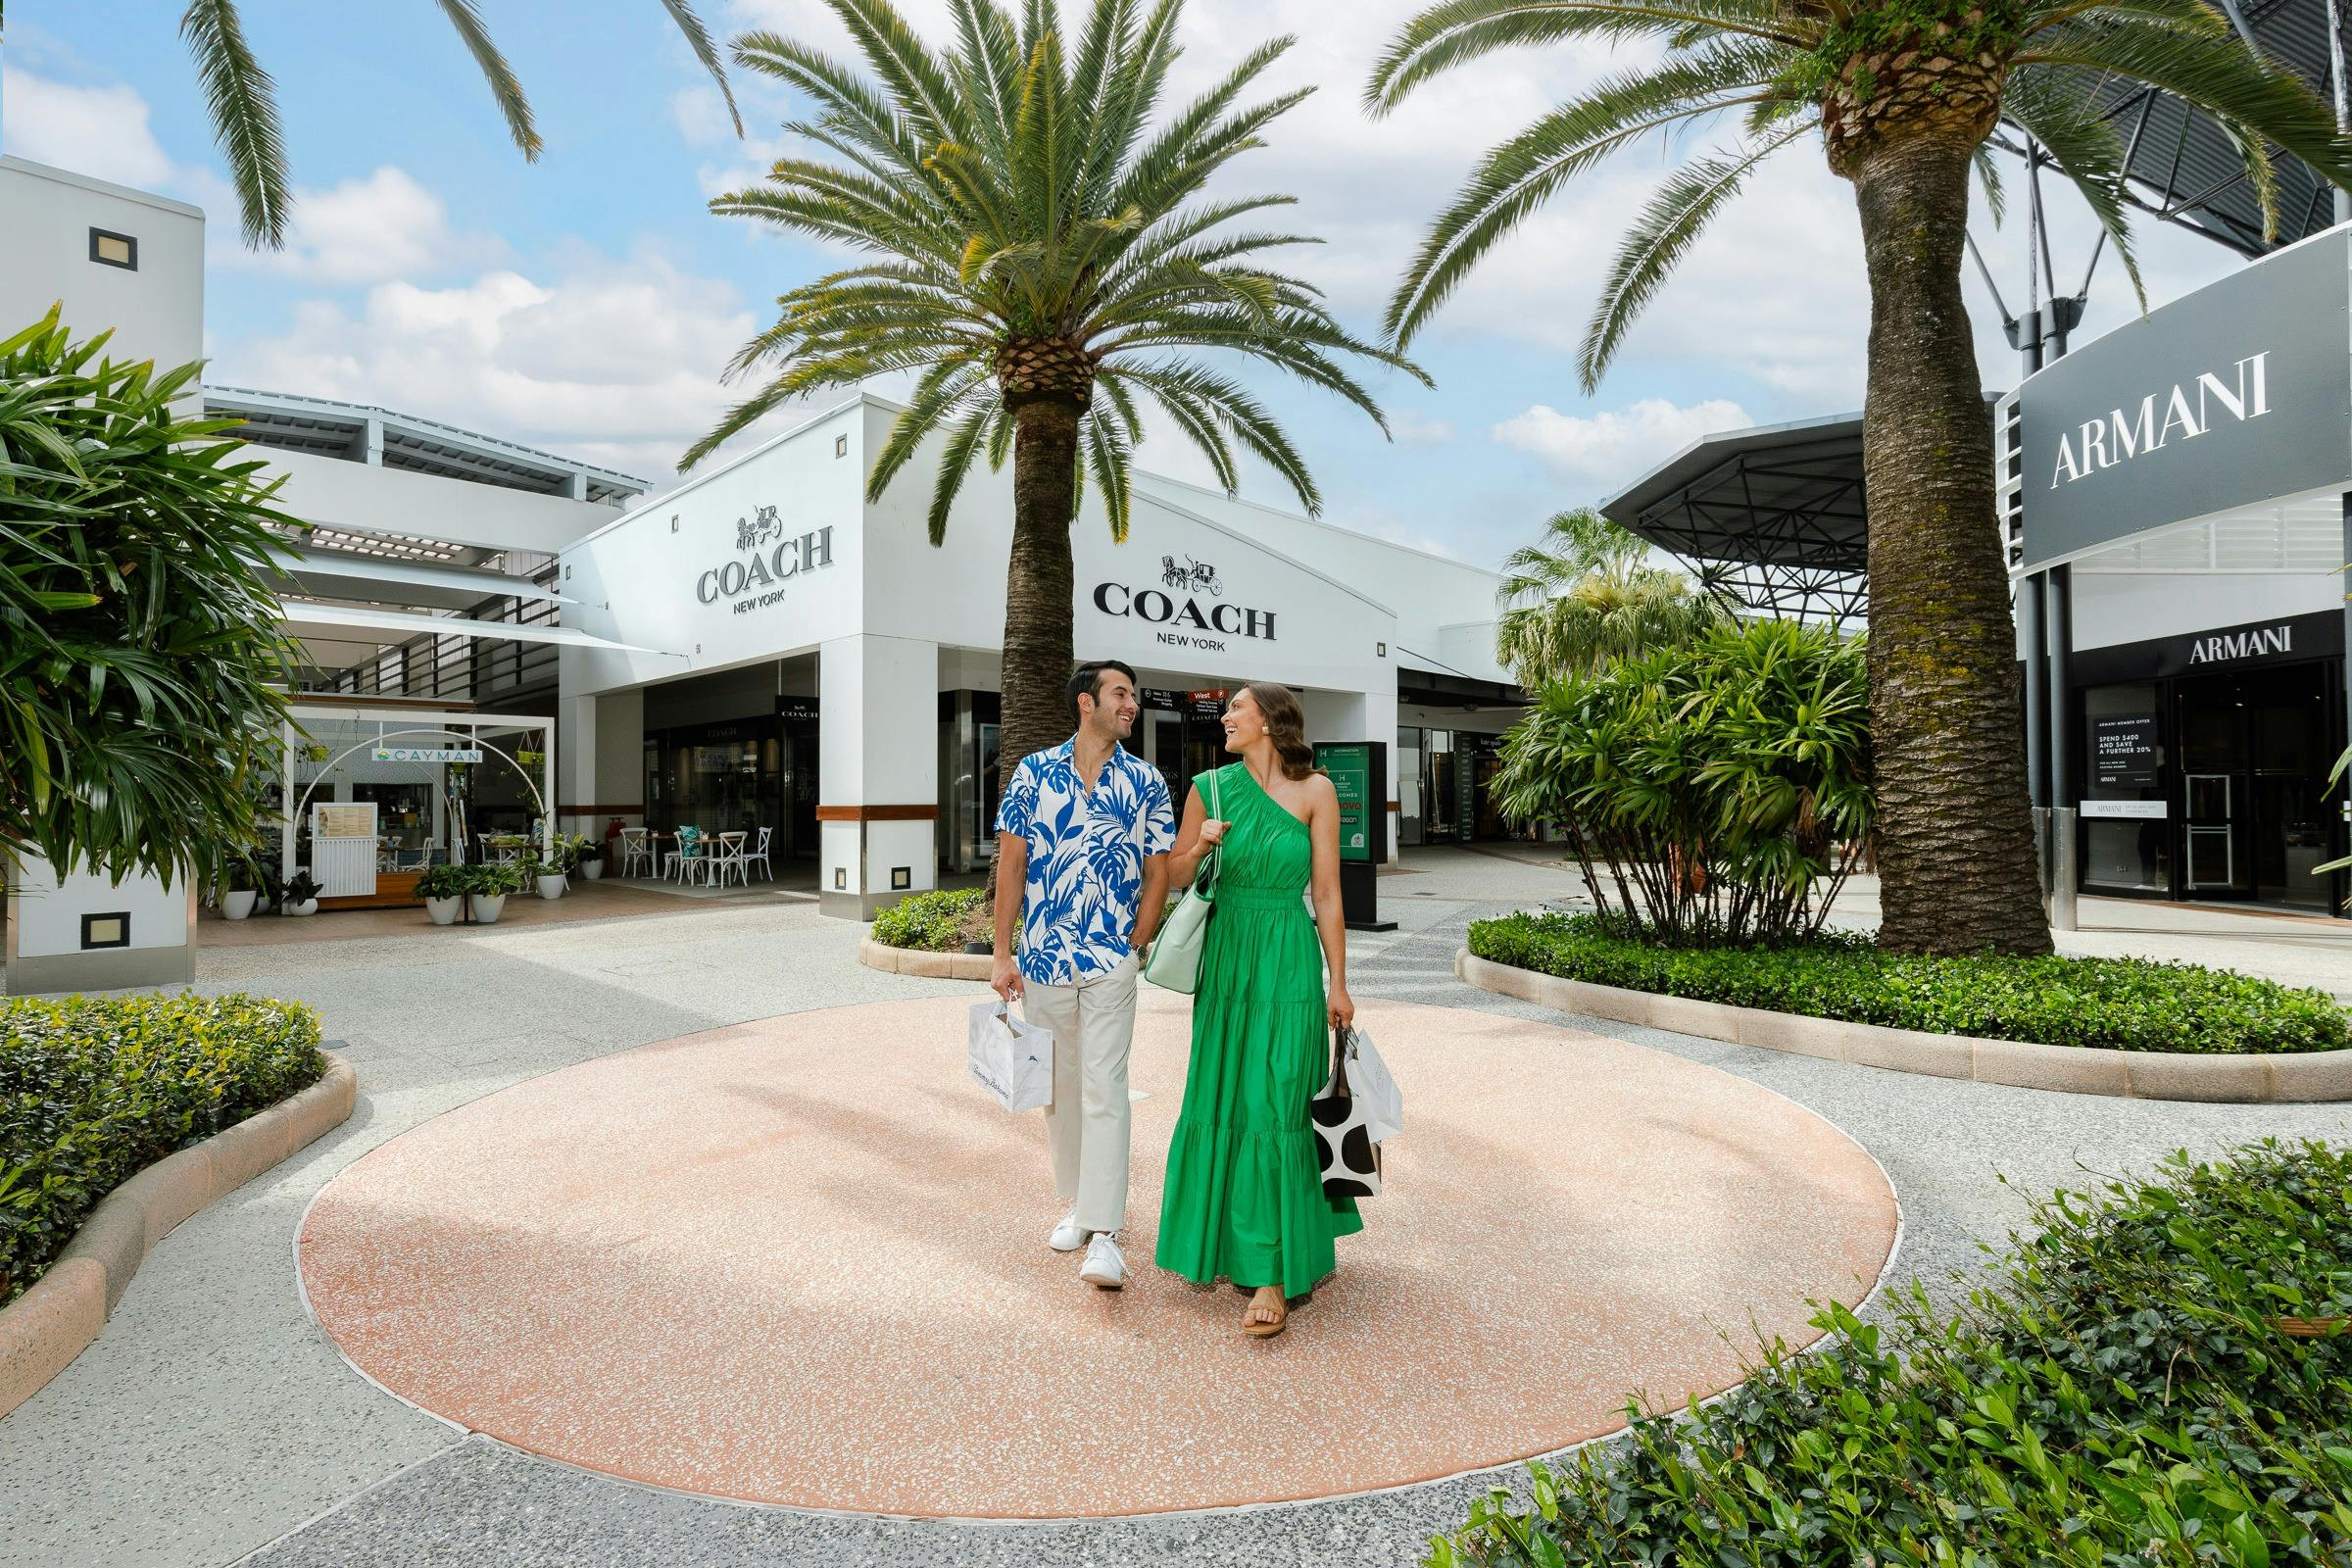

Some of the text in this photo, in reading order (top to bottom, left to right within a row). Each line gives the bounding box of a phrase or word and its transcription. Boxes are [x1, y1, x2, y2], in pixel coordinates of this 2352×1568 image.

[2049, 350, 2273, 490] ARMANI
[696, 524, 833, 604] COACH
[733, 589, 785, 614] NEW YORK
[1093, 582, 1278, 641] COACH
[1156, 632, 1225, 653] NEW YORK
[2188, 625, 2293, 664] ARMANI
[394, 750, 479, 761] CAYMAN
[2097, 805, 2123, 813] ARMANI
